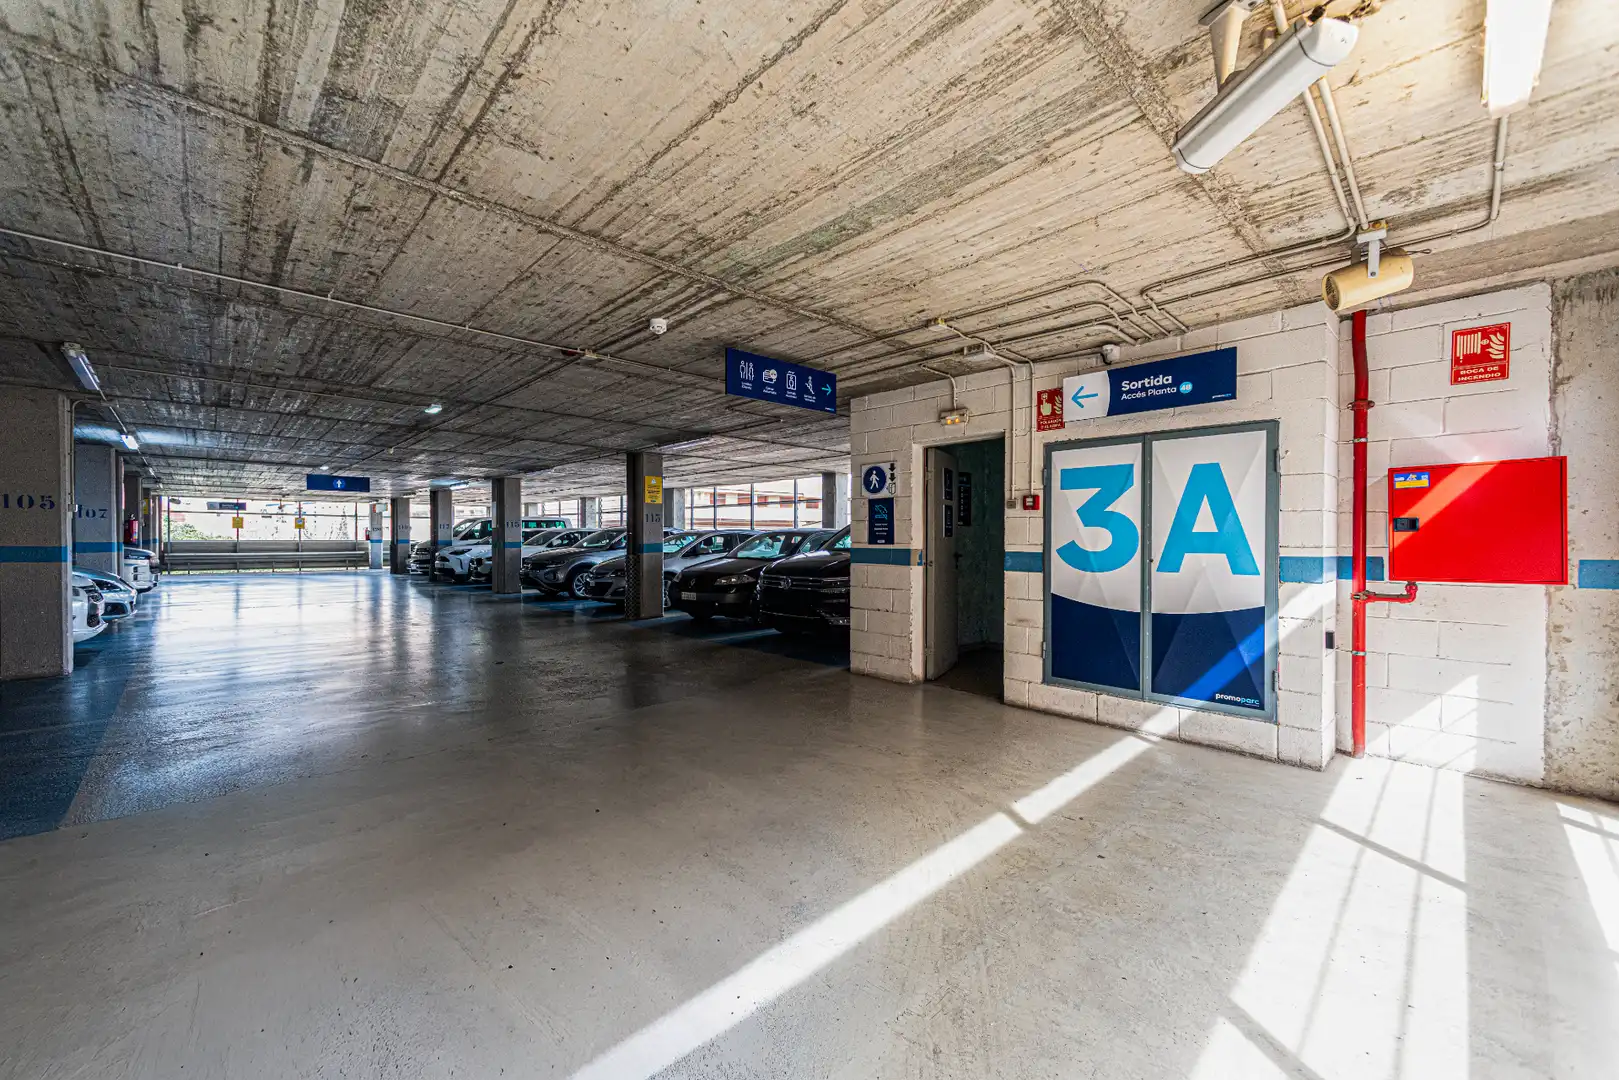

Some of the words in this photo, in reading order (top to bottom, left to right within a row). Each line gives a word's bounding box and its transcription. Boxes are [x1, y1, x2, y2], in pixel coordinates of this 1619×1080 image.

[1121, 375, 1173, 391] Sortida
[1458, 372, 1501, 381] INCENDIO
[1121, 390, 1147, 400] Accés
[1147, 386, 1177, 397] Planta
[3, 493, 56, 510] 105
[1215, 693, 1260, 704] promoparc
